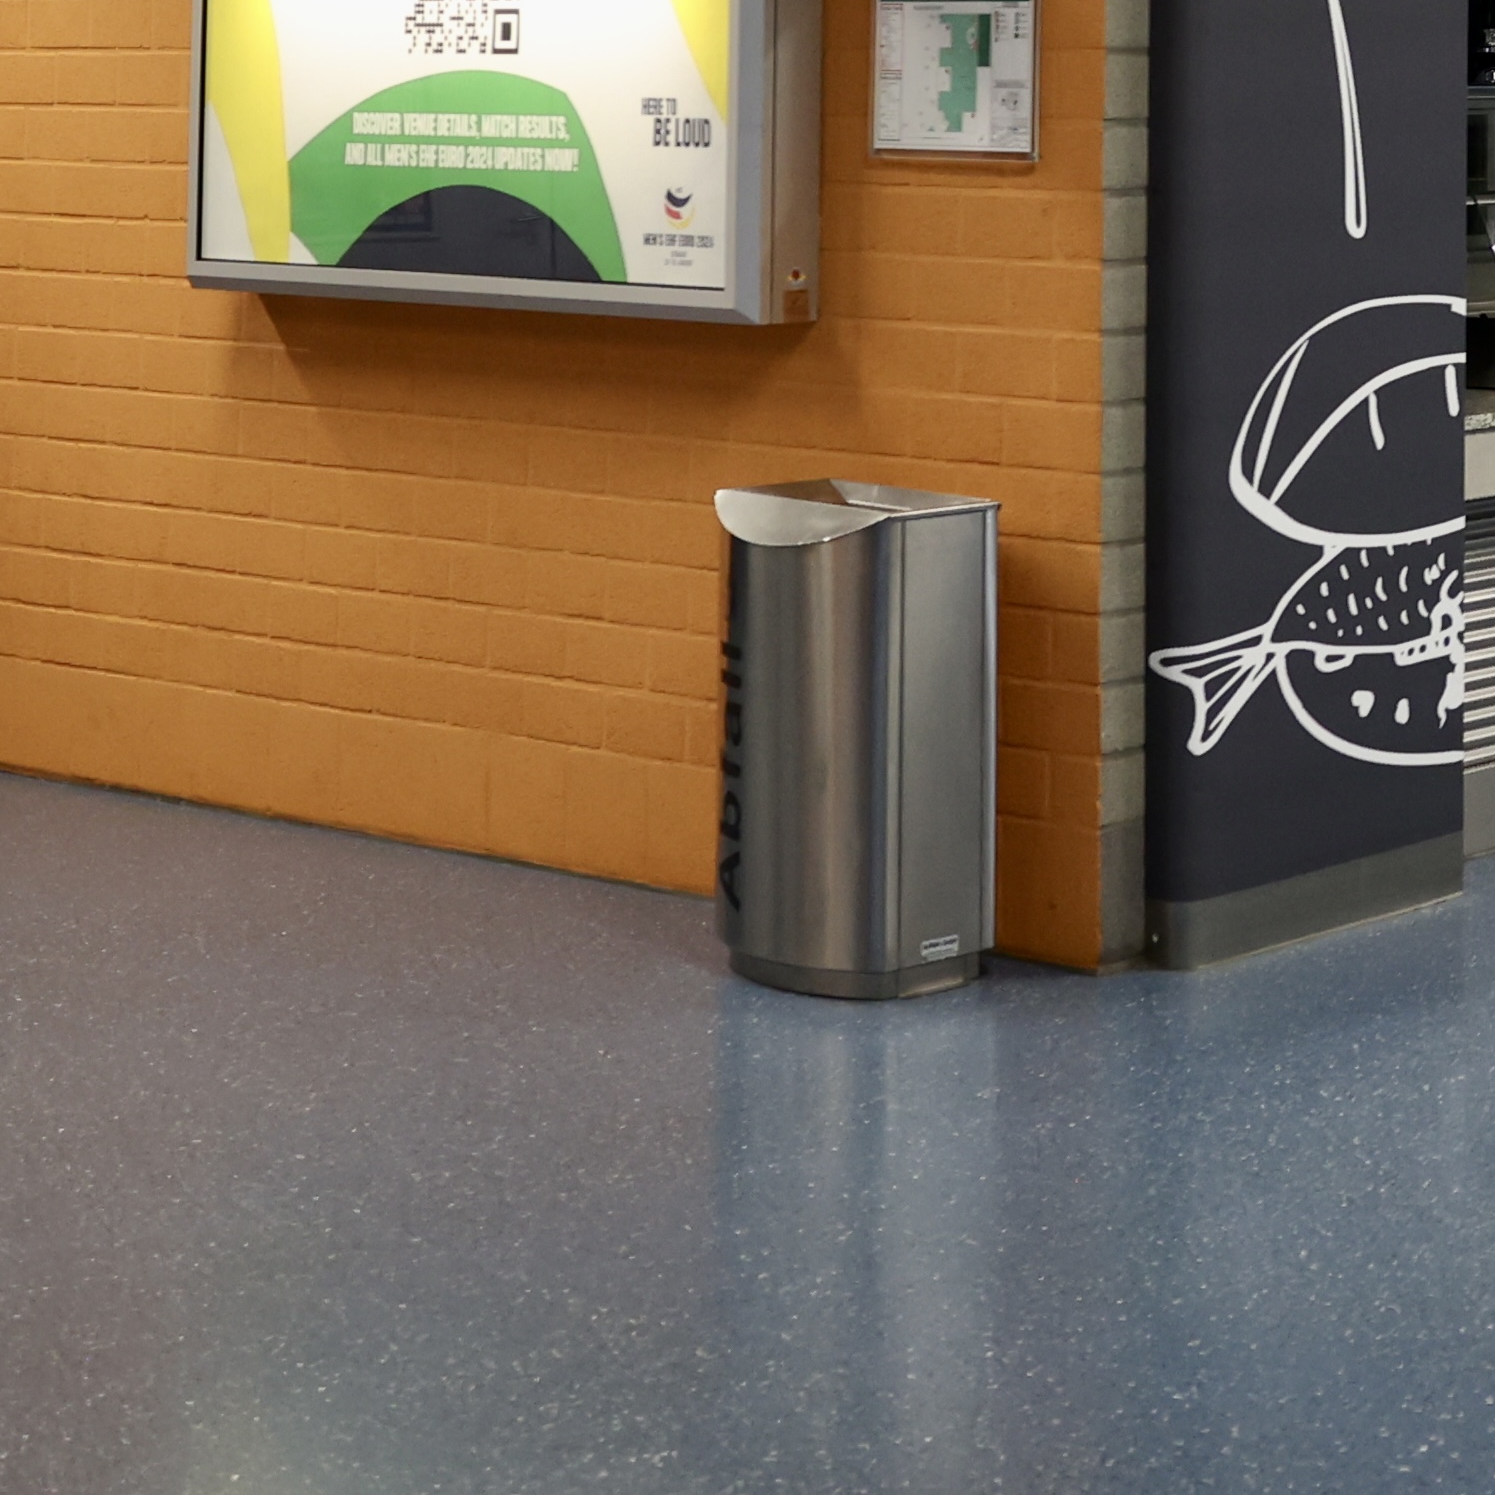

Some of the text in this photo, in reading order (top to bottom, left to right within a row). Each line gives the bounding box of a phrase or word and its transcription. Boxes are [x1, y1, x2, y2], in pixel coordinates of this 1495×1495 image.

[641, 98, 677, 116] HERE TO
[352, 112, 401, 135] DISCOVER
[403, 113, 437, 136] VENUE
[653, 118, 712, 147] BE LOUD
